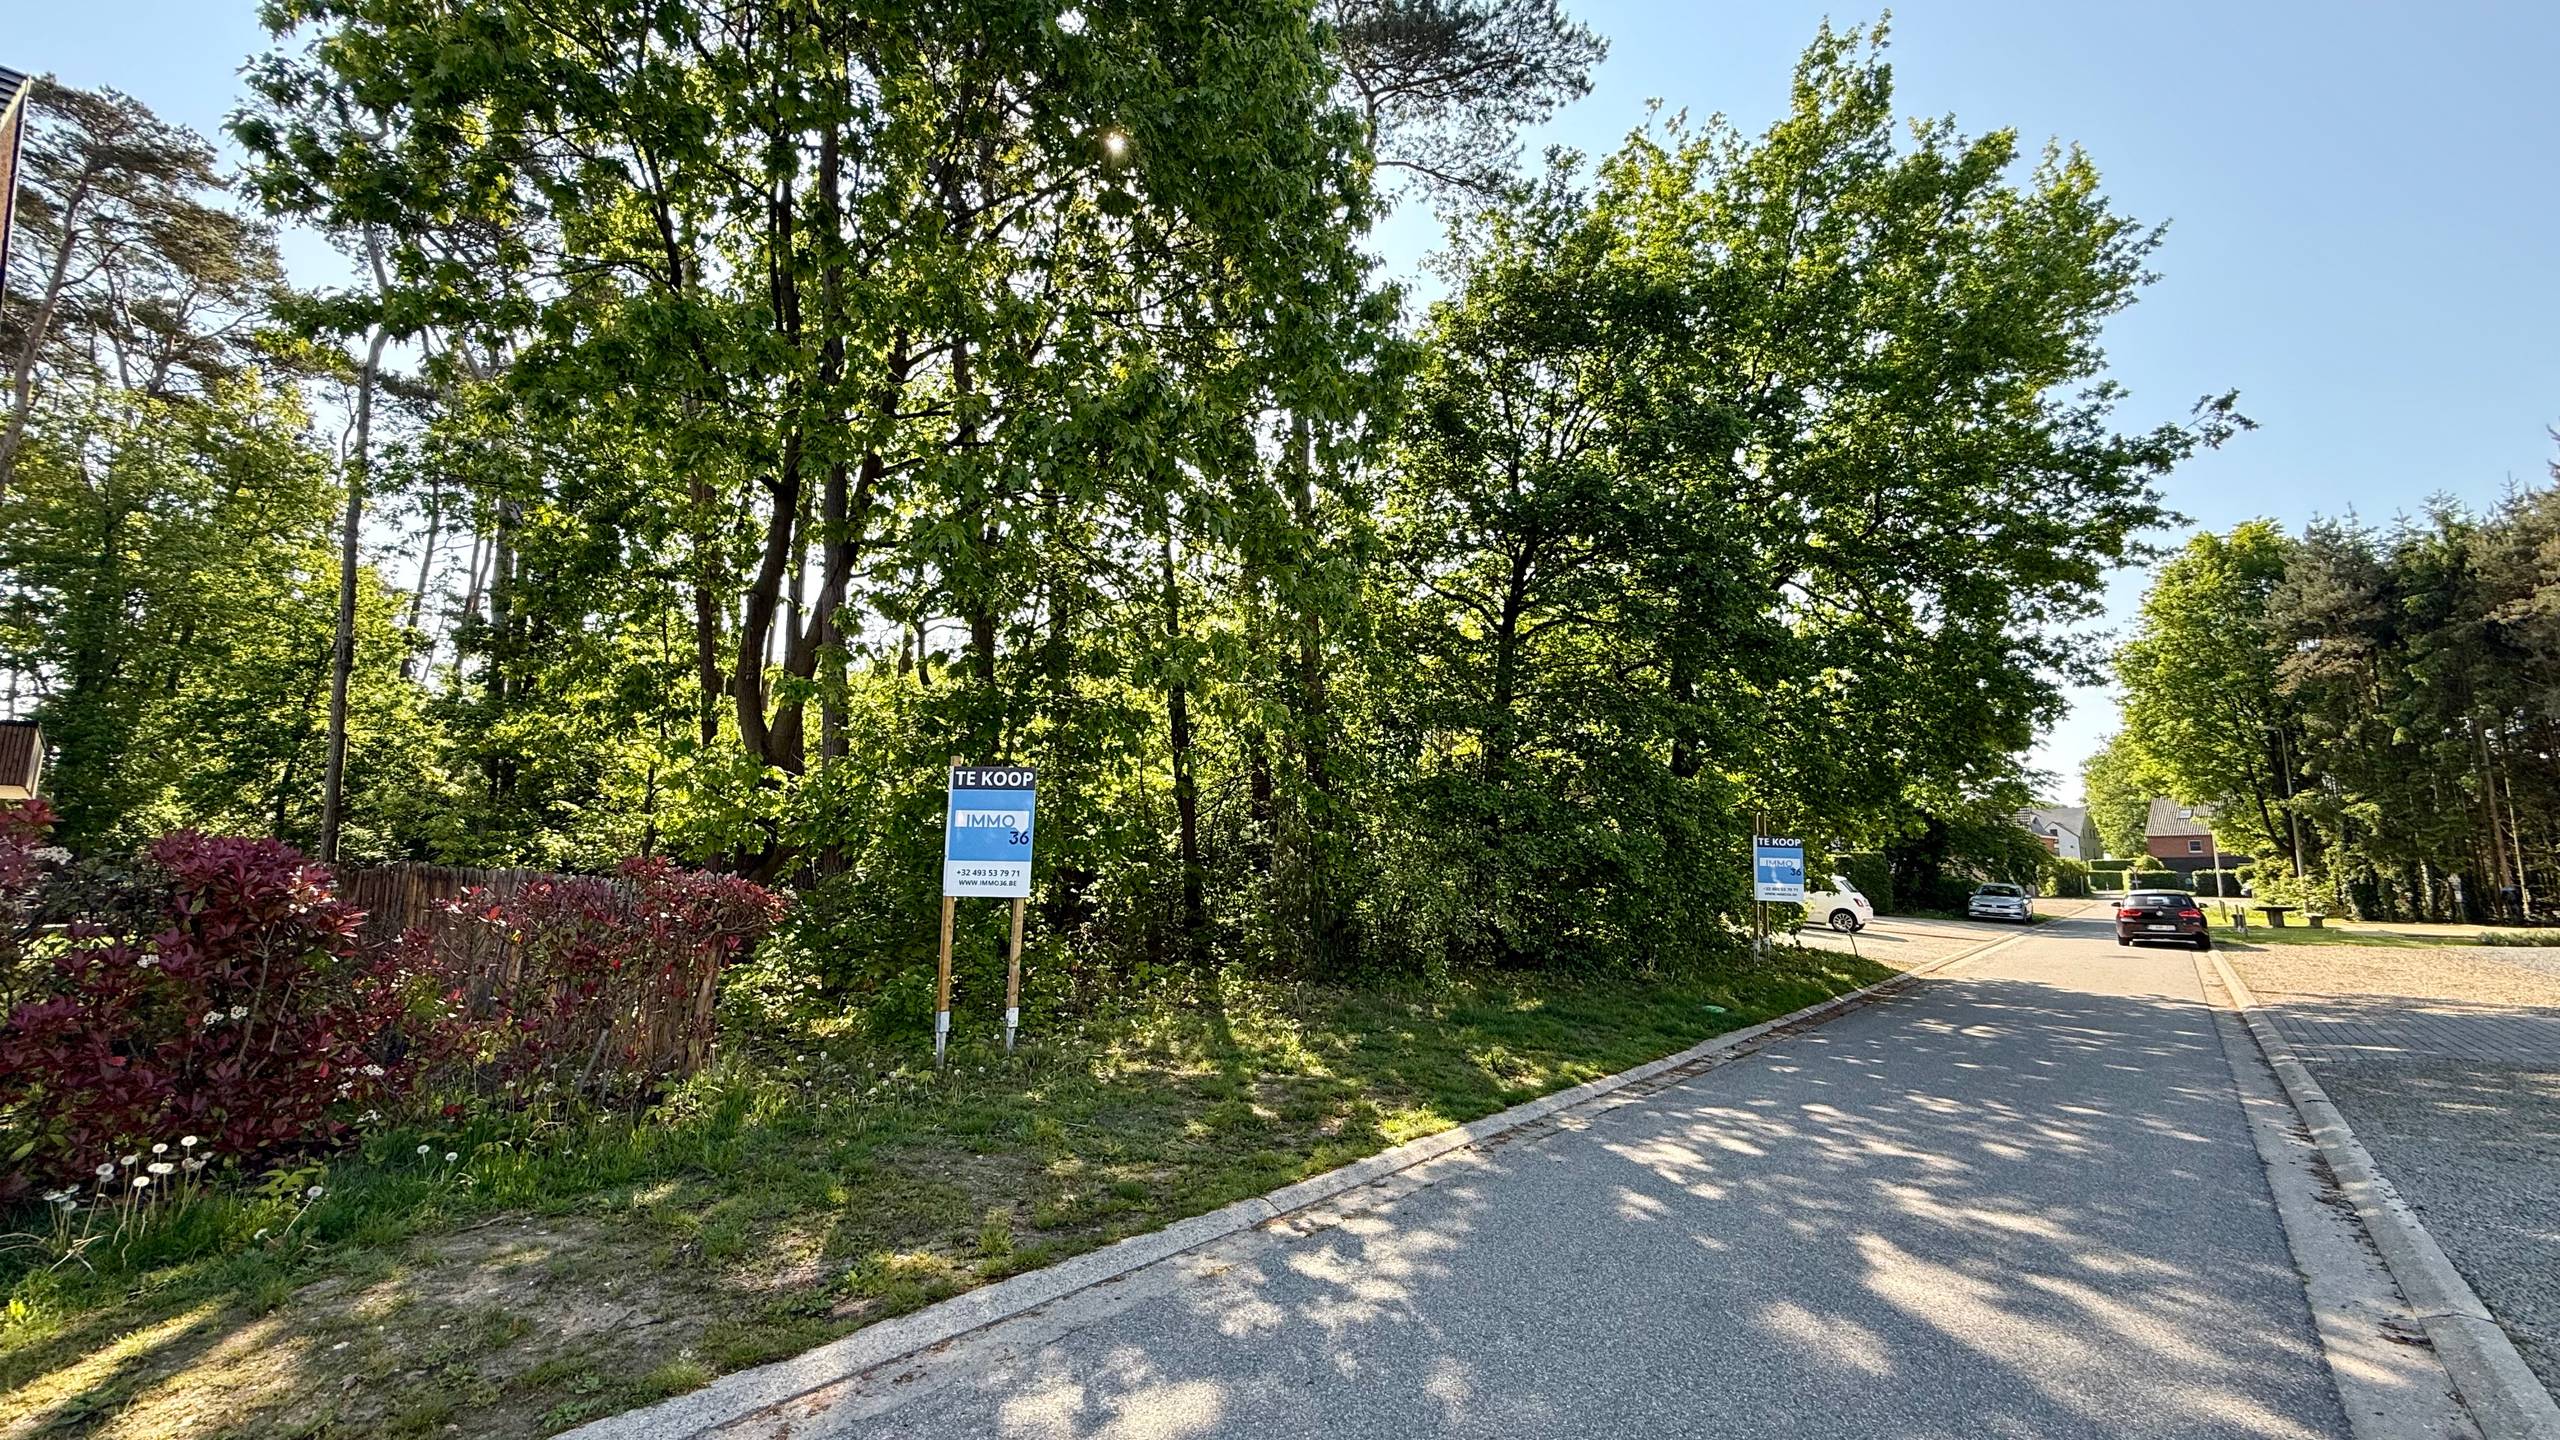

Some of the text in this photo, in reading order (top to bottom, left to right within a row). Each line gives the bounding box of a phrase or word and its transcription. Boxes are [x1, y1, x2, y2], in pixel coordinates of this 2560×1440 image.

[955, 771, 1034, 787] TE KOOP
[966, 814, 1016, 828] IMMO
[1008, 831, 1030, 845] 36
[1758, 838, 1802, 847] TE KOOP
[956, 869, 971, 877] +32
[972, 869, 987, 877] 493
[988, 869, 998, 877] 53
[1000, 869, 1010, 877] 79
[1790, 868, 1802, 876] 36
